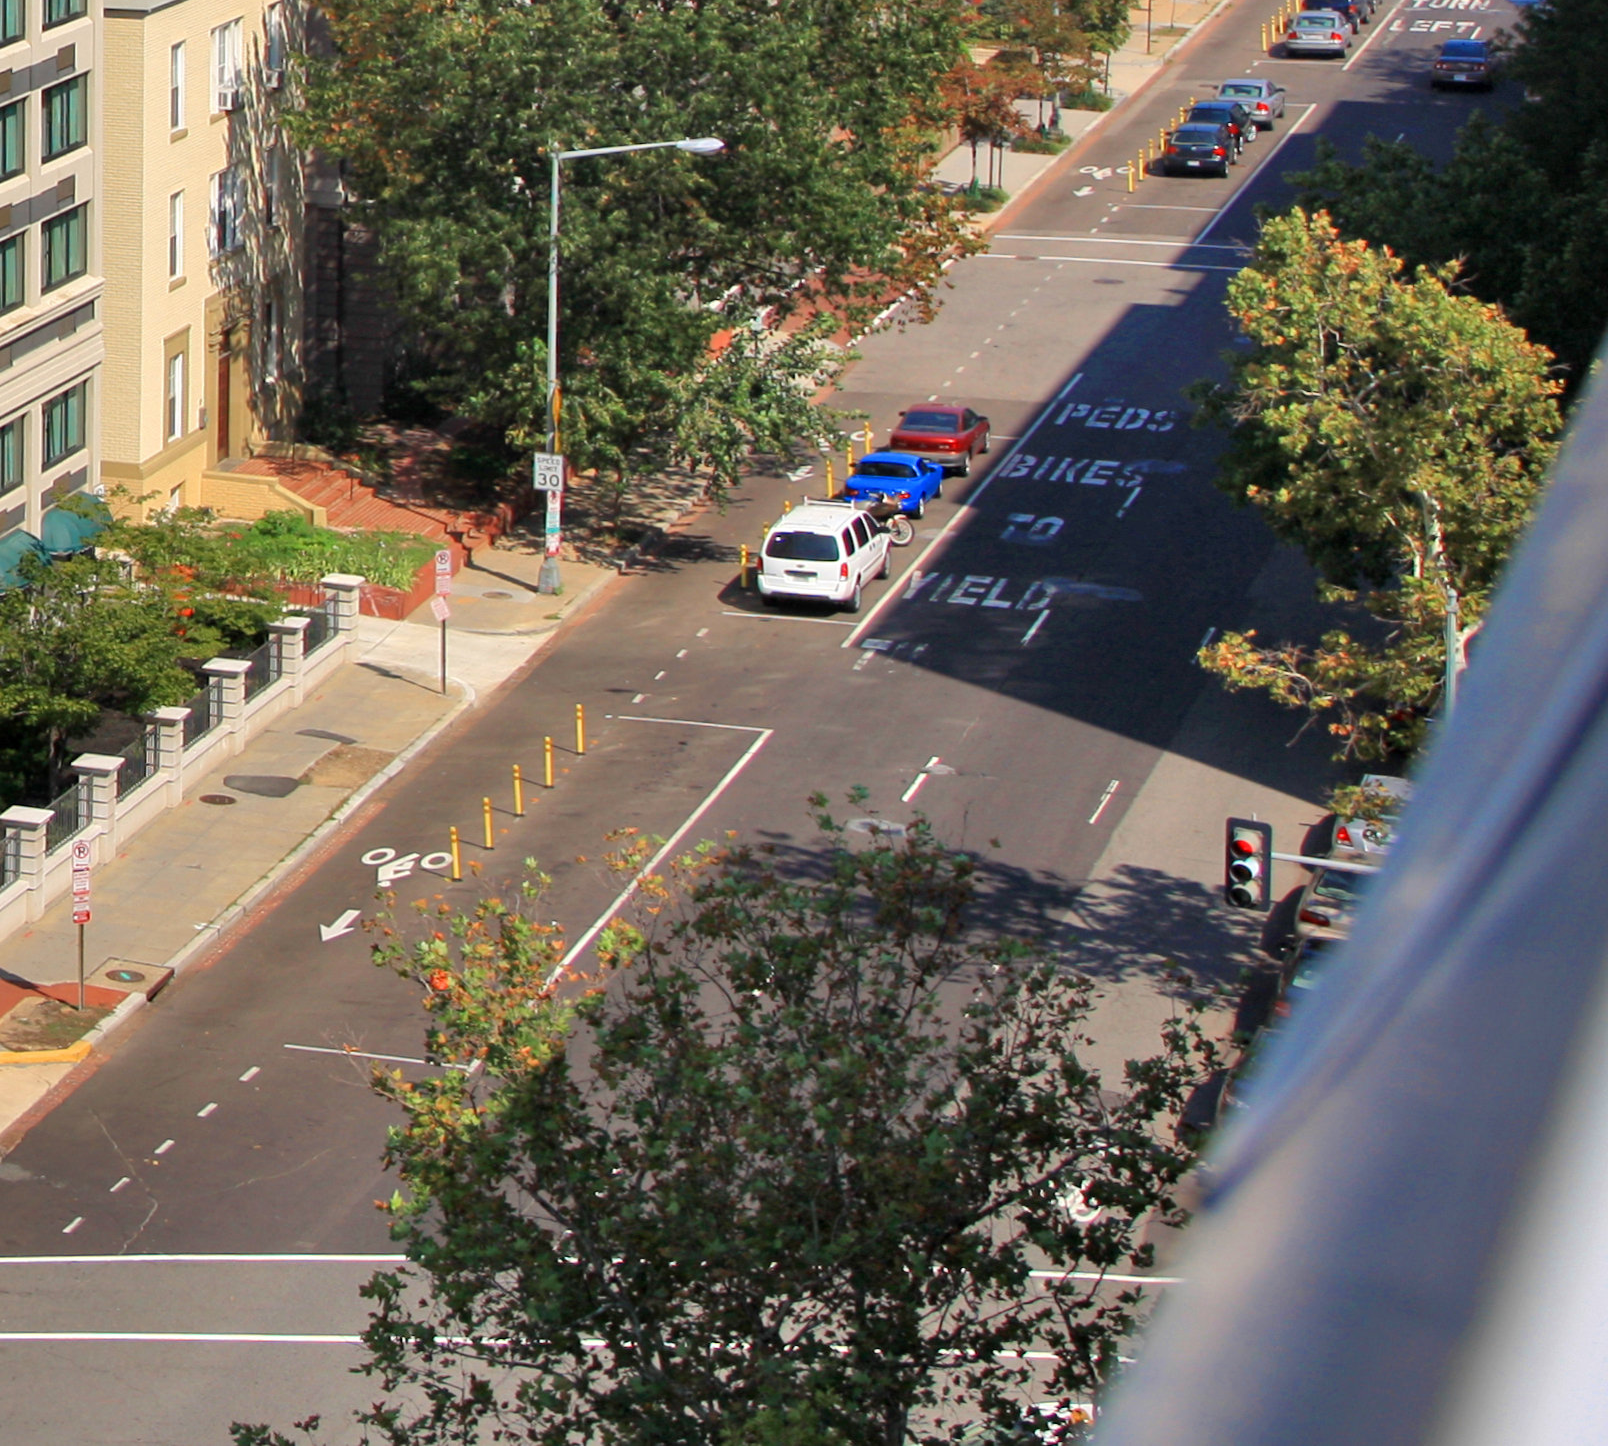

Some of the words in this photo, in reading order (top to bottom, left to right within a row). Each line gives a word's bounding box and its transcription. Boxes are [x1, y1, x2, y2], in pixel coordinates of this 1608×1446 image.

[1388, 18, 1476, 33] LEFT
[1054, 403, 1179, 432] PEDS
[537, 456, 561, 465] SPEED
[998, 454, 1144, 487] BIKES
[538, 472, 560, 487] 30
[999, 512, 1065, 541] TO
[901, 570, 1057, 611] YIELD
